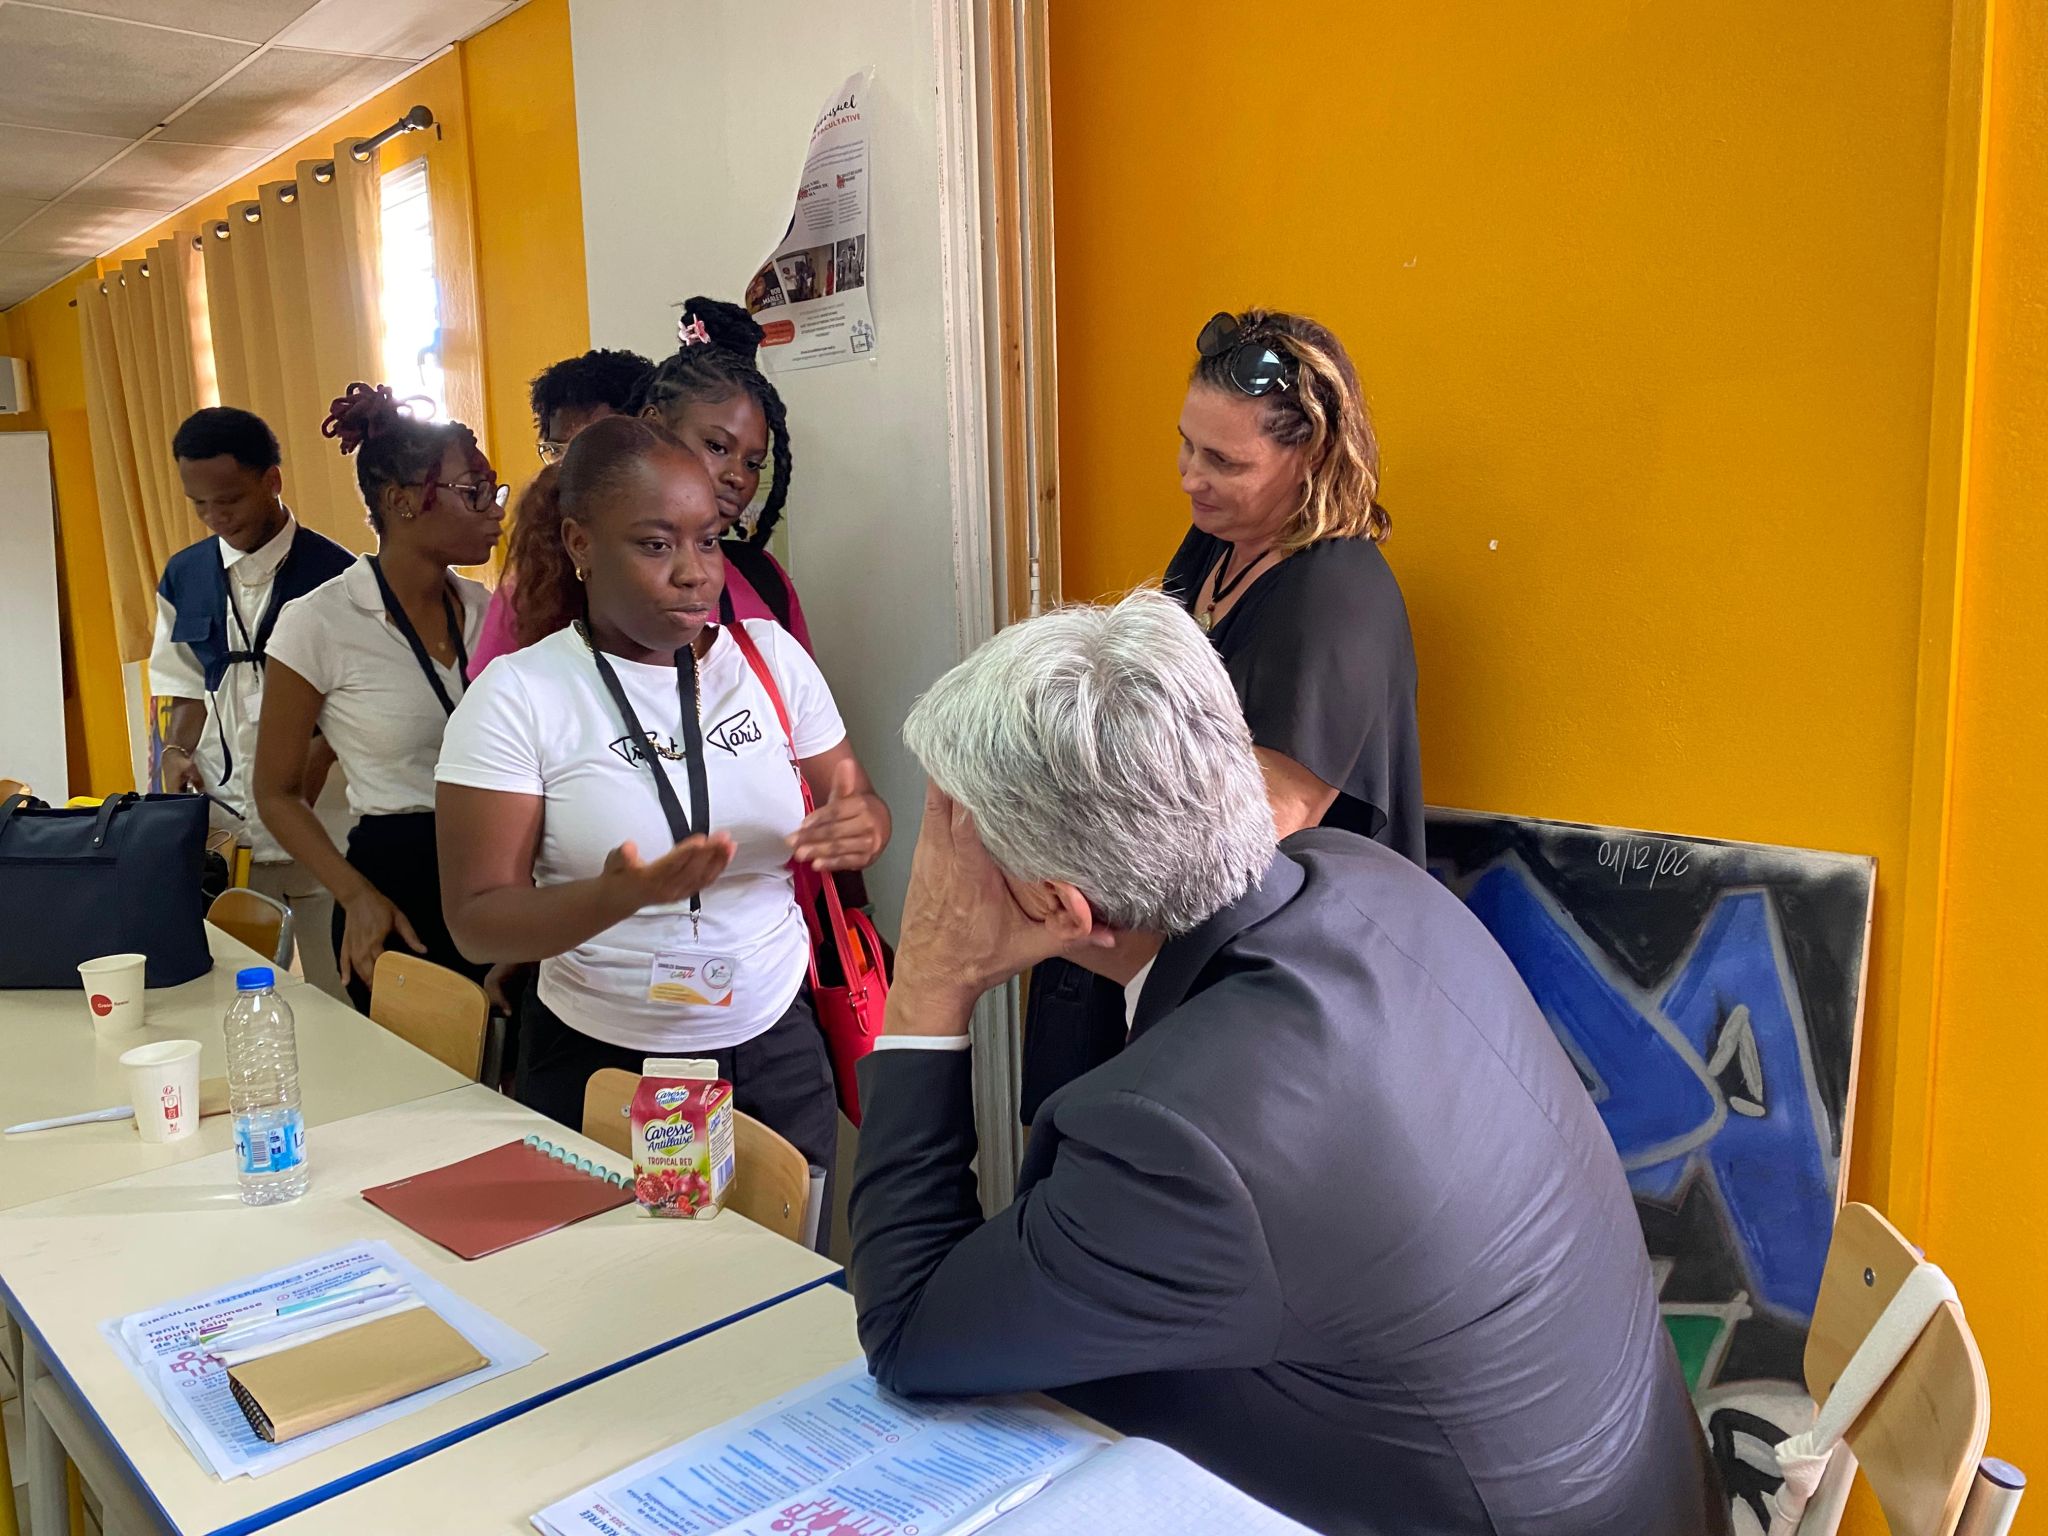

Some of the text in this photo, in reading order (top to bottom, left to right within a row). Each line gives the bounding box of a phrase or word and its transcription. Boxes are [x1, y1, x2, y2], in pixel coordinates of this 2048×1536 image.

[706, 709, 762, 757] Paris
[645, 1121, 693, 1142] Caresse
[647, 1135, 693, 1152] Antillaise
[648, 1157, 693, 1166] TROPICAL RED
[138, 1302, 211, 1327] CIRCULAIRE
[217, 1277, 292, 1305] INTERACTIVE
[304, 1268, 320, 1277] DE
[145, 1324, 182, 1338] Tenir
[200, 1302, 262, 1324] promesse
[150, 1317, 234, 1343] républicaine
[153, 1340, 171, 1350] de
[579, 1509, 620, 1536] RENTRÉE
